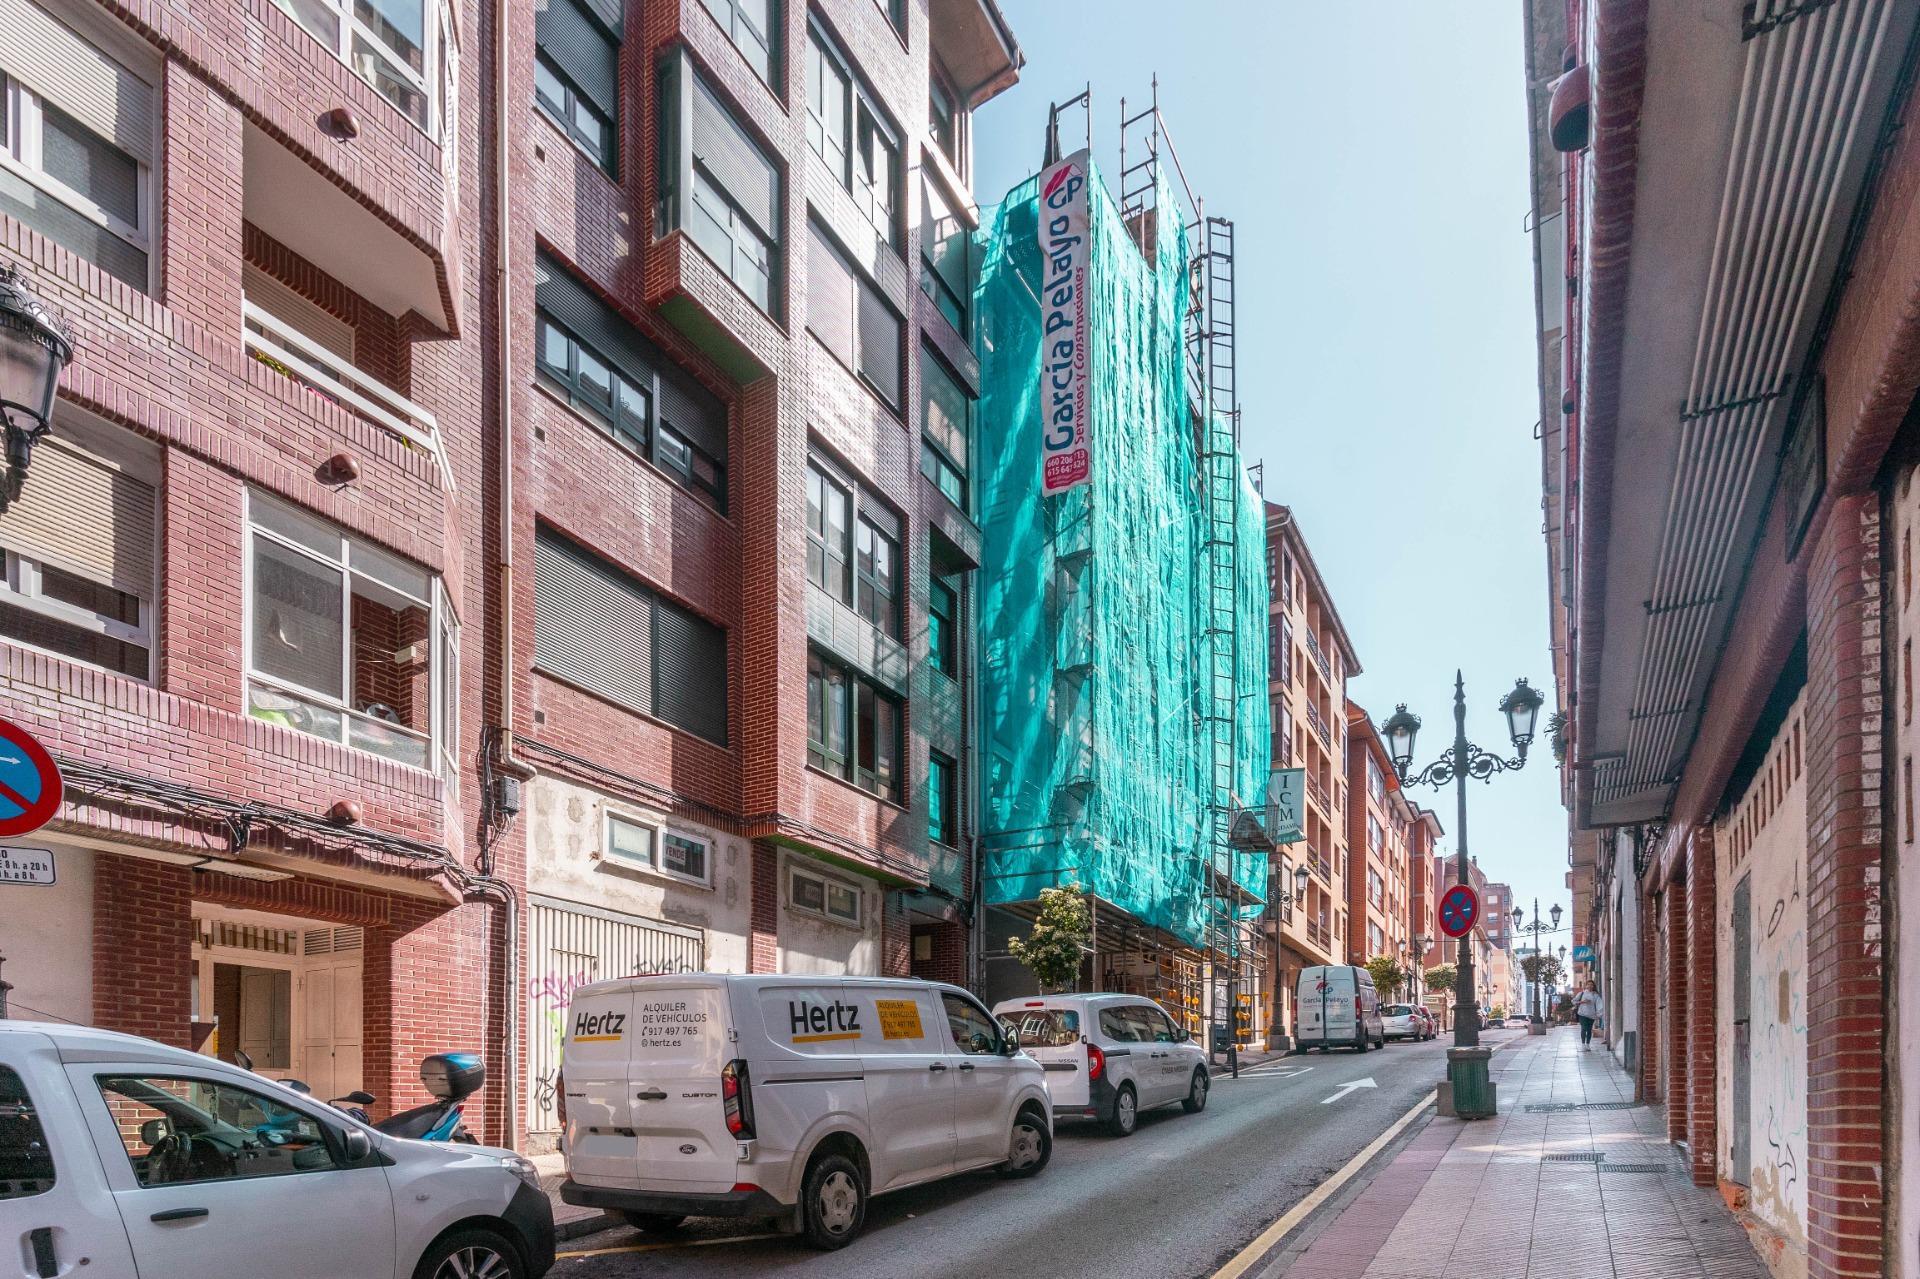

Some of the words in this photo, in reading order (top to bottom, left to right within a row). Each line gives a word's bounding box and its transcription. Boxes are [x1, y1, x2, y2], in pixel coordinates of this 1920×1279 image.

[1048, 176, 1083, 209] GP
[1044, 215, 1081, 336] Pelayo
[1073, 266, 1085, 370] Construcciones
[1076, 373, 1086, 381] y
[1045, 339, 1075, 451] García
[1074, 383, 1085, 445] Servicios
[1047, 466, 1060, 478] 615
[30, 862, 41, 871] 20
[643, 1002, 686, 1013] ALQUILER
[788, 1000, 861, 1034] Hertz
[574, 1010, 626, 1036] Hertz
[642, 1014, 654, 1024] DE
[655, 1013, 707, 1023] VEHÍCULOS
[648, 1027, 663, 1036] 917
[665, 1026, 680, 1035] 497
[682, 1026, 698, 1035] 765
[650, 1039, 682, 1047] hertz.es
